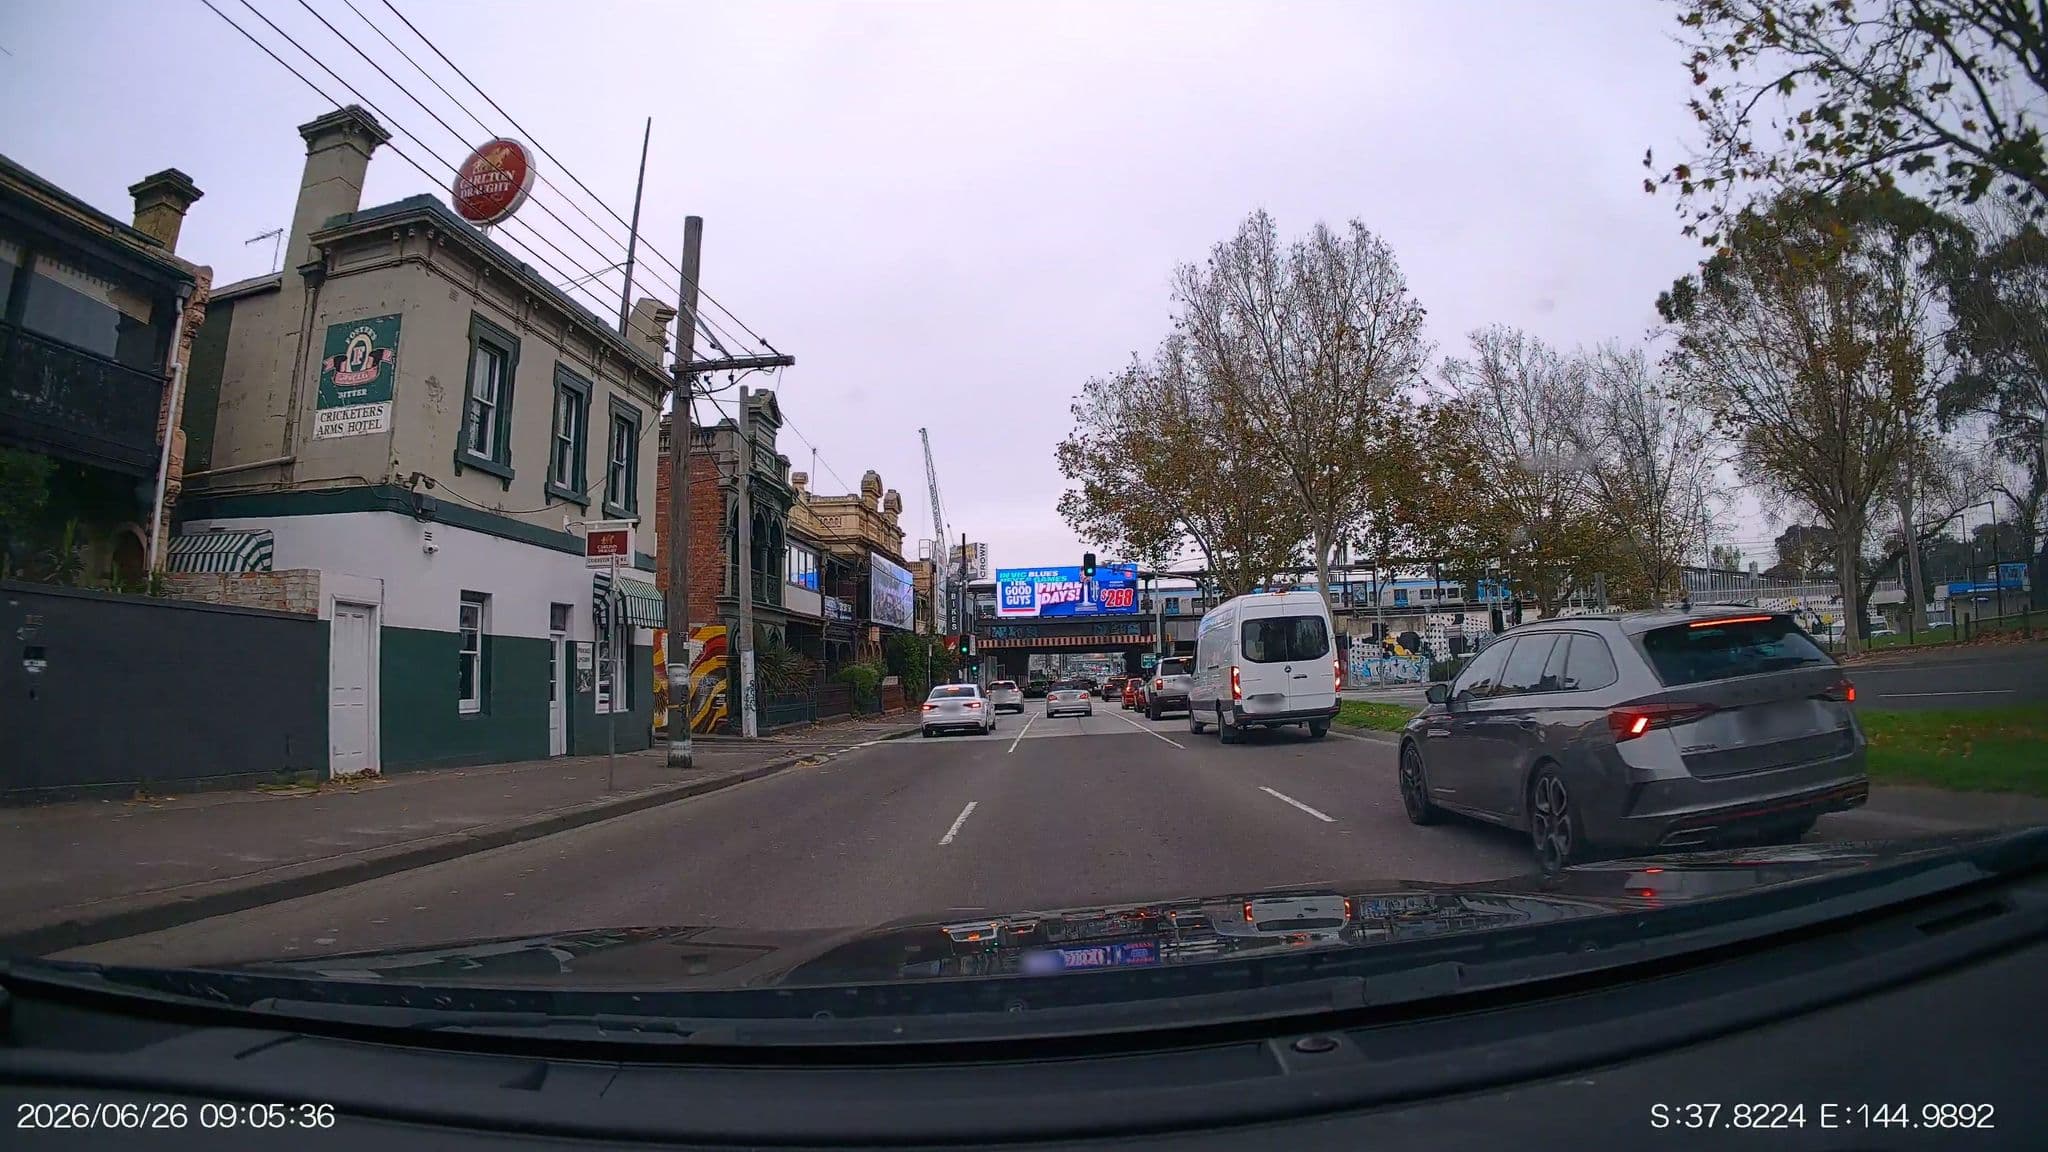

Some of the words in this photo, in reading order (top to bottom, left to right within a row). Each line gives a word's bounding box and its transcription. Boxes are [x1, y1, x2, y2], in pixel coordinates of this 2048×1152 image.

[460, 169, 516, 189] CARLTON
[460, 182, 510, 199] DRAUGHT
[337, 388, 368, 399] BITTER
[320, 405, 384, 423] CRICKETERS
[316, 422, 344, 437] ARMS
[347, 418, 382, 433] HOTEL
[979, 542, 987, 578] CROWN
[1005, 586, 1032, 596] GOOD
[1006, 595, 1031, 605] GUYS
[1040, 588, 1081, 605] DAYS!
[1100, 588, 1134, 608] $268
[950, 593, 958, 631] BIKES
